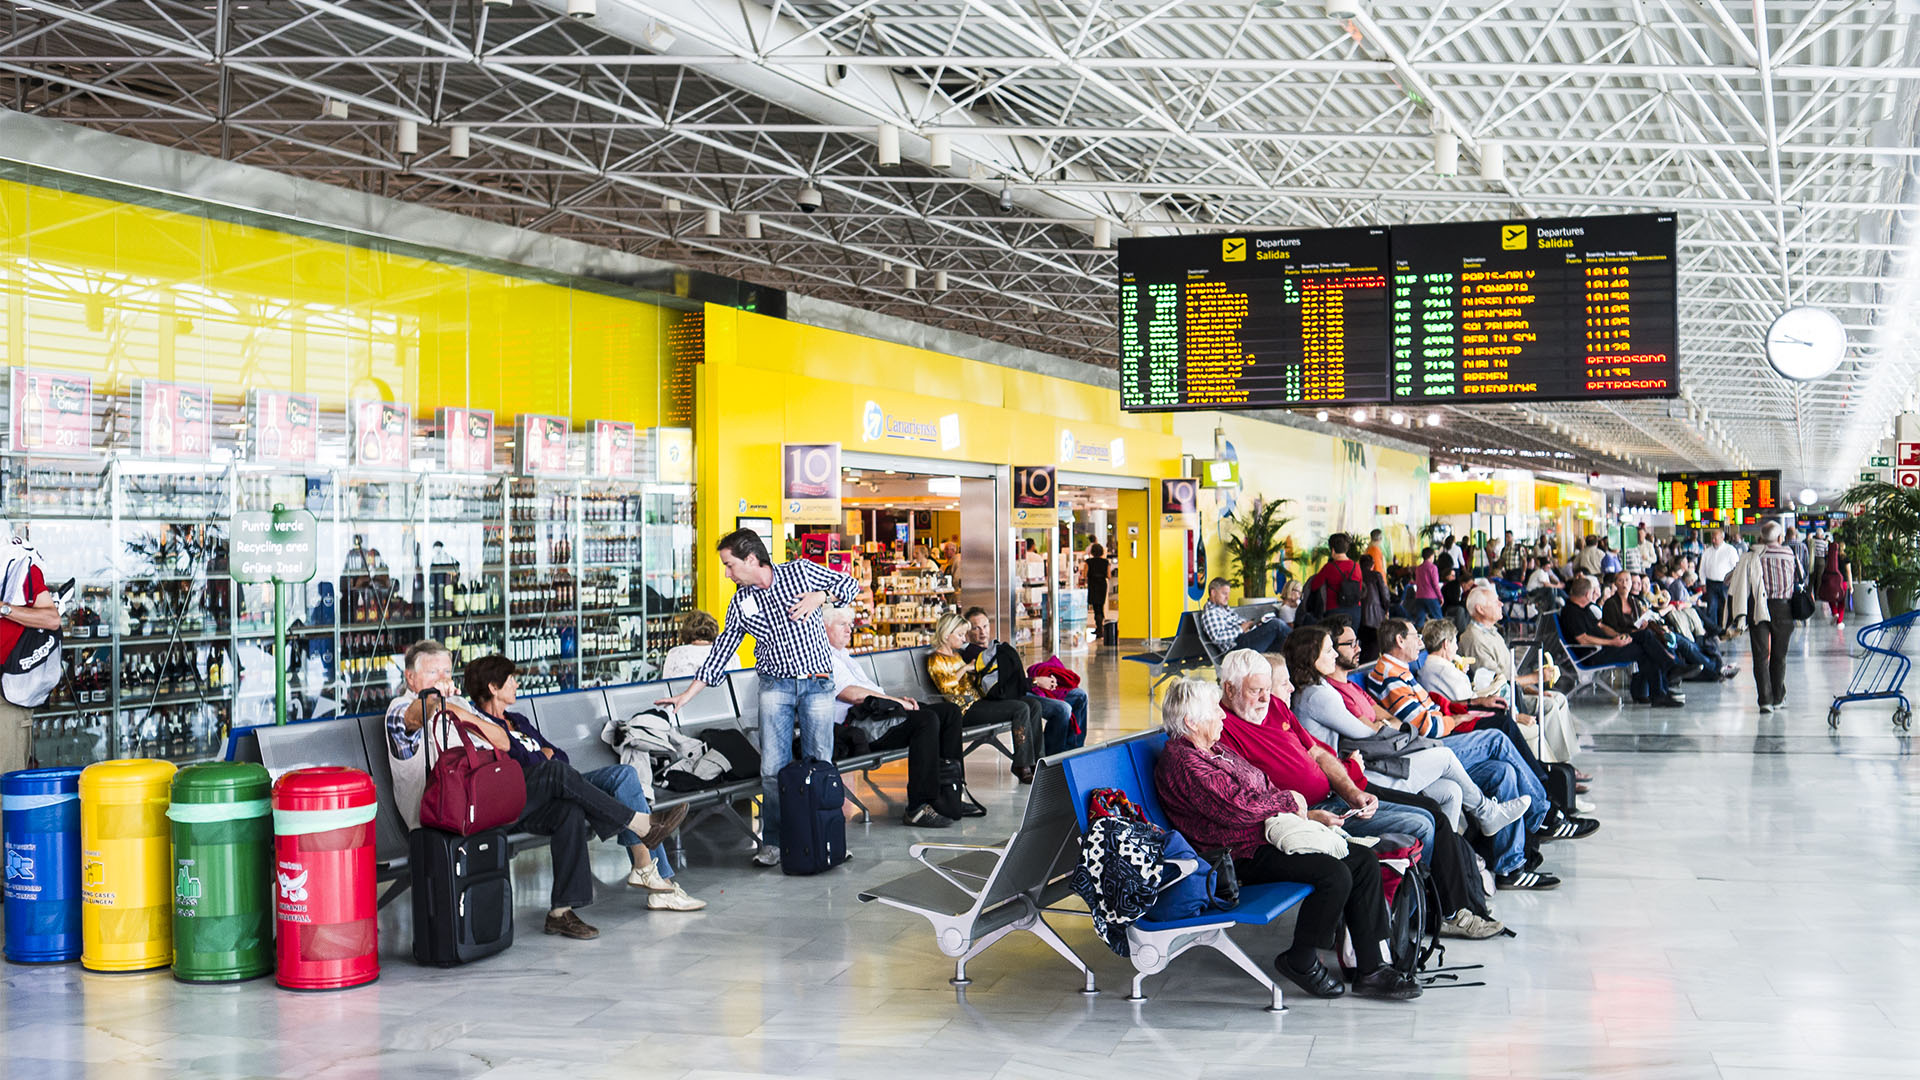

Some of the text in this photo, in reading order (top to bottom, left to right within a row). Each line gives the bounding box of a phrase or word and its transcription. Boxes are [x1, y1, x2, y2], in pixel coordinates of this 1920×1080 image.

[1537, 227, 1585, 238] Departures
[1256, 238, 1301, 249] Departures
[1538, 238, 1574, 249] Salidas
[1256, 250, 1290, 261] Salidas
[57, 400, 80, 411] Offer
[886, 414, 937, 437] Canariensis
[790, 448, 832, 482] 10
[1018, 468, 1051, 496] 10
[1166, 481, 1194, 504] 10
[242, 520, 304, 532] Punto verde
[236, 540, 308, 555] Recycling area
[242, 561, 303, 574] Grüne Insel
